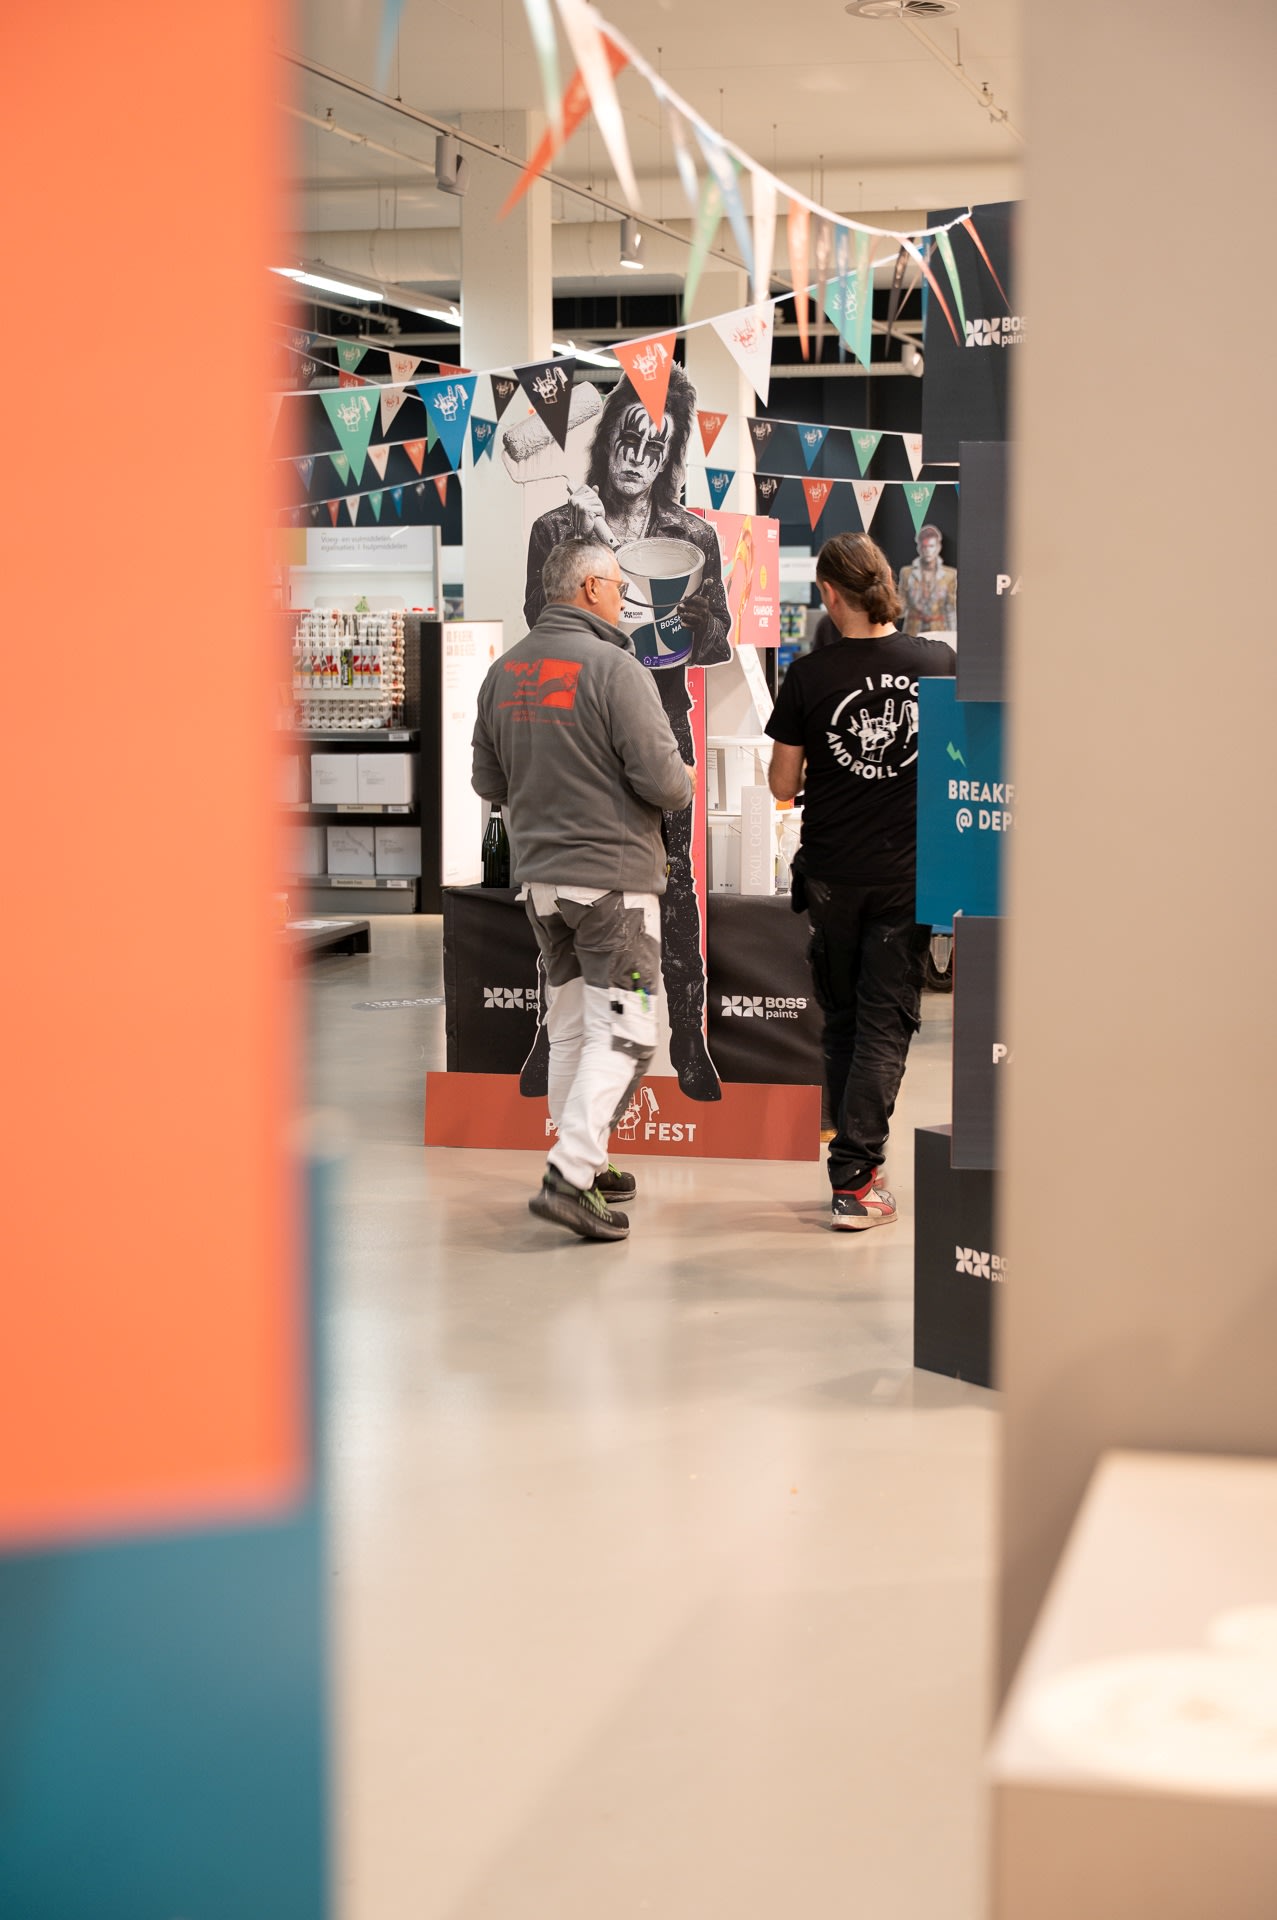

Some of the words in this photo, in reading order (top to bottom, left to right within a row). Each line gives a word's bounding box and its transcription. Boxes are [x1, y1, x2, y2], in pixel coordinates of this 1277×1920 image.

[865, 676, 874, 691] I
[956, 807, 973, 834] @
[750, 851, 762, 887] PAUL
[765, 996, 807, 1010] BOSS
[765, 1009, 799, 1020] paints
[644, 1122, 697, 1143] FEST
